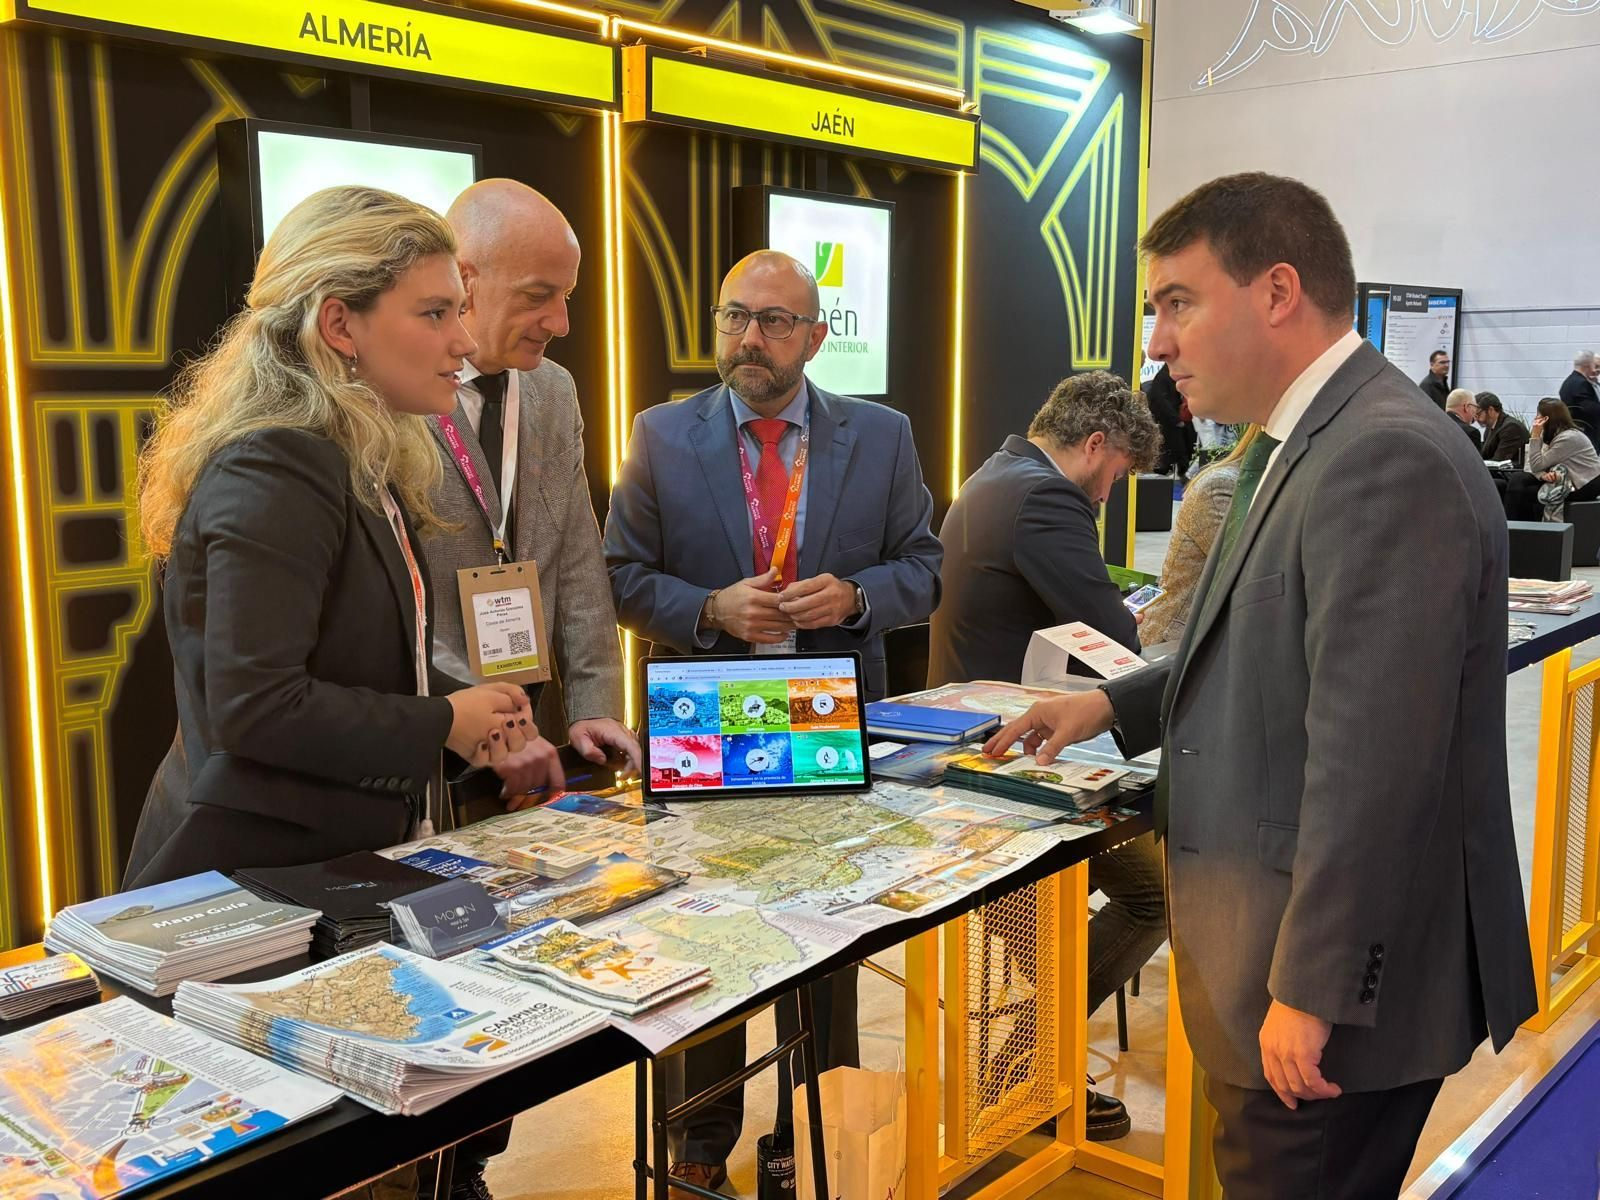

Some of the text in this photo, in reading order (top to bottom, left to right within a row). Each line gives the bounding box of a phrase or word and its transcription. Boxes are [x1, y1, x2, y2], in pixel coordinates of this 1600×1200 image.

[299, 12, 432, 60] ALMERÍA
[811, 108, 854, 137] JAÉN
[820, 297, 857, 336] én
[828, 342, 869, 353] INTERIOR
[495, 596, 511, 605] wtm
[152, 901, 249, 929] Mapa Guía
[434, 903, 476, 924] MOON
[482, 1002, 548, 1033] CAMPING
[767, 1161, 780, 1169] CITY
[781, 1158, 795, 1169] WATE
